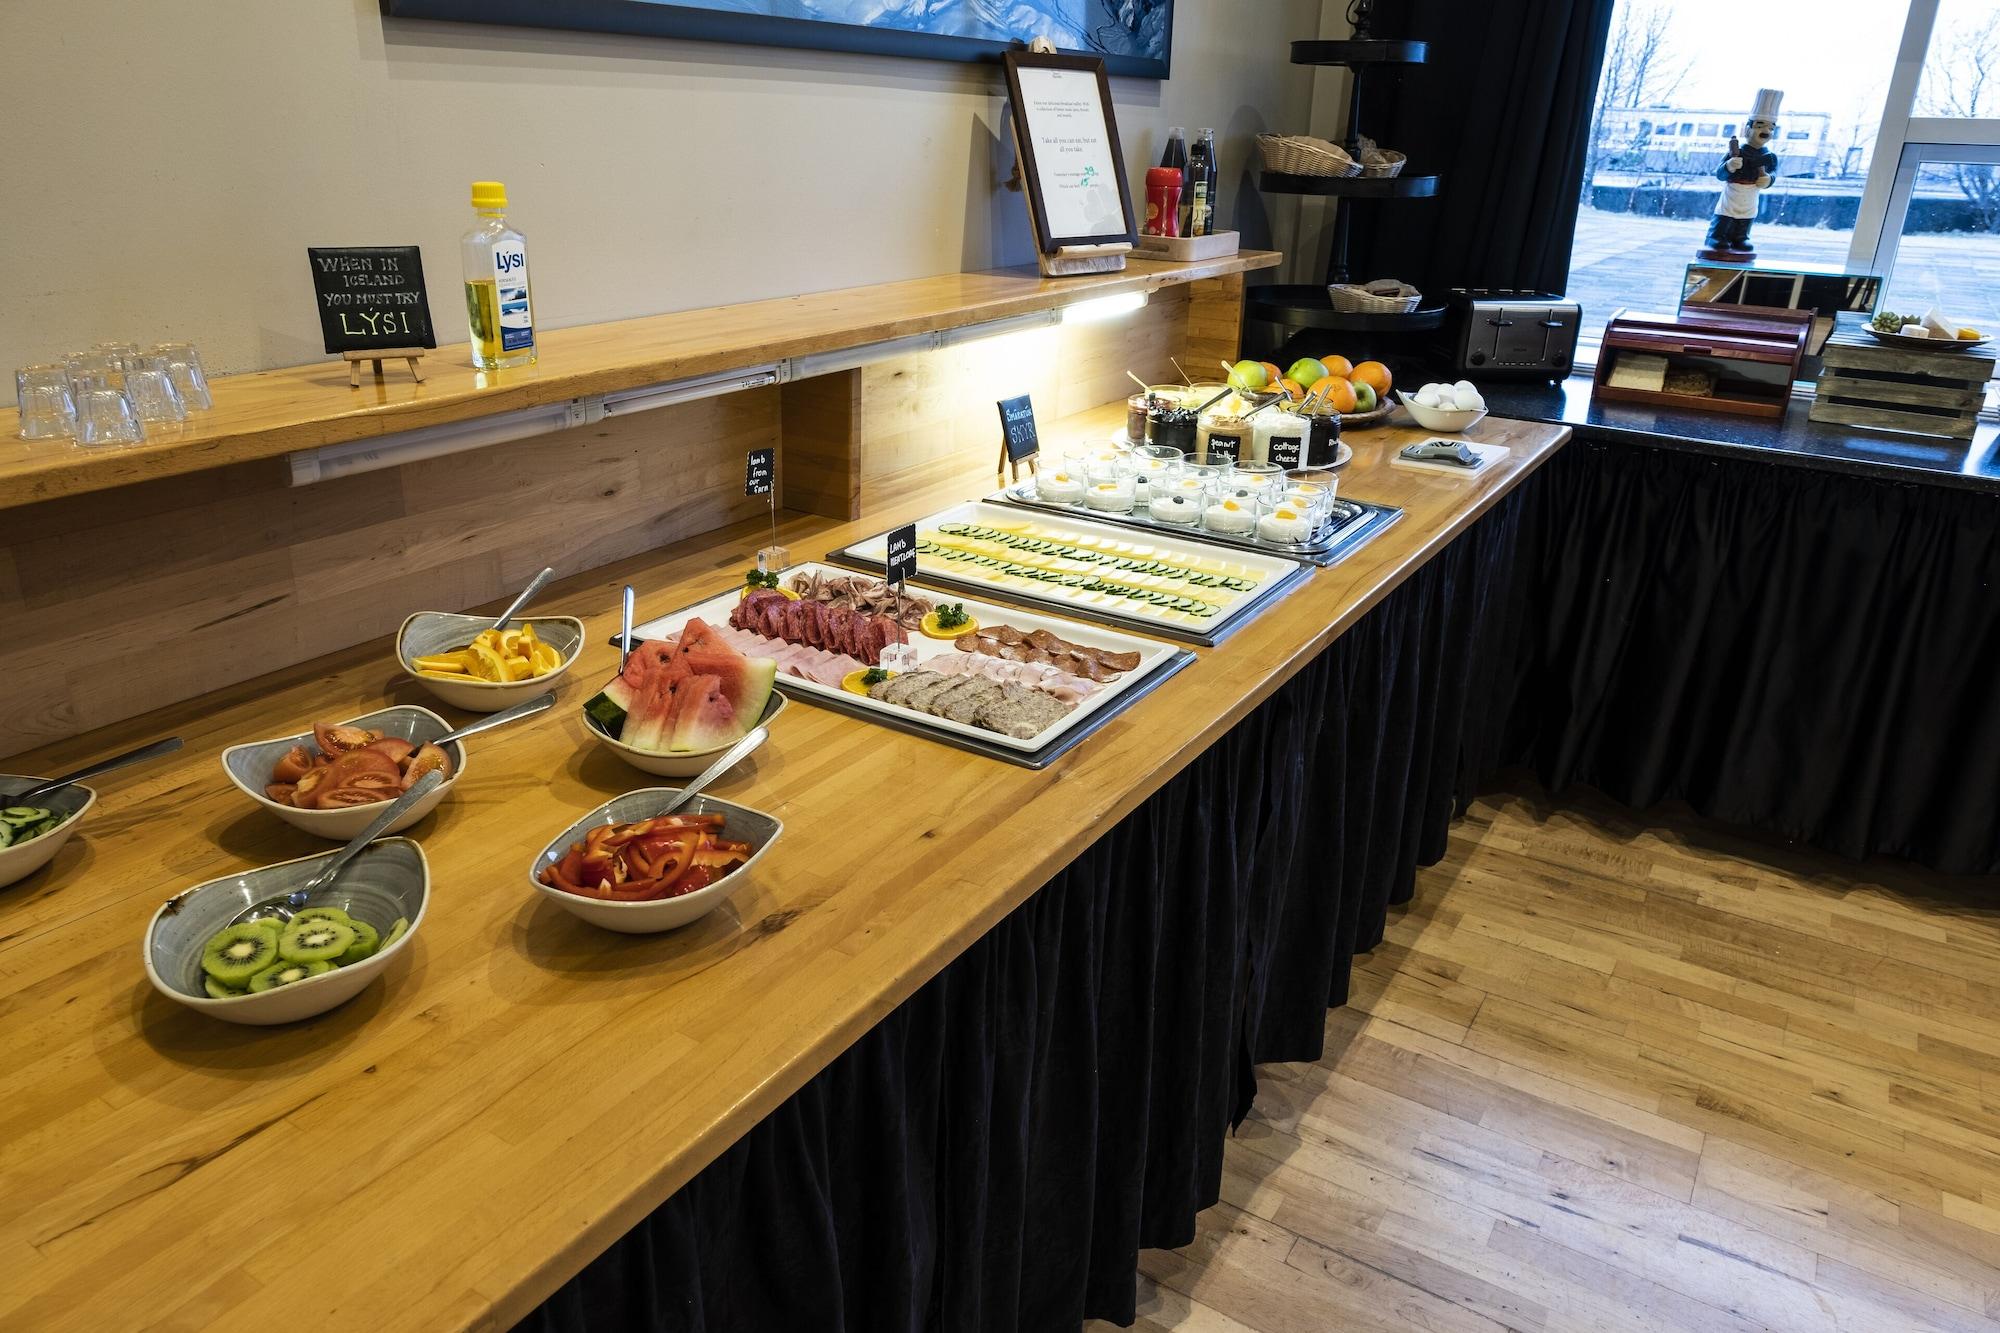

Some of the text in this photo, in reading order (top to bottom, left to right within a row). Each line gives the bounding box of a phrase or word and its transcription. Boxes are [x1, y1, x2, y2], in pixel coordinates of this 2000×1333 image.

[316, 256, 400, 273] WHEN IN
[343, 274, 406, 287] ICELAND
[323, 291, 421, 307] YOU MUST TRY
[339, 307, 411, 336] LÝSI
[1011, 422, 1036, 444] SKYR
[1210, 438, 1237, 450] peanut
[1273, 441, 1300, 453] cottage
[751, 455, 766, 466] lamb
[1275, 453, 1298, 462] cheese
[753, 467, 767, 478] from
[889, 538, 907, 554] LAMb
